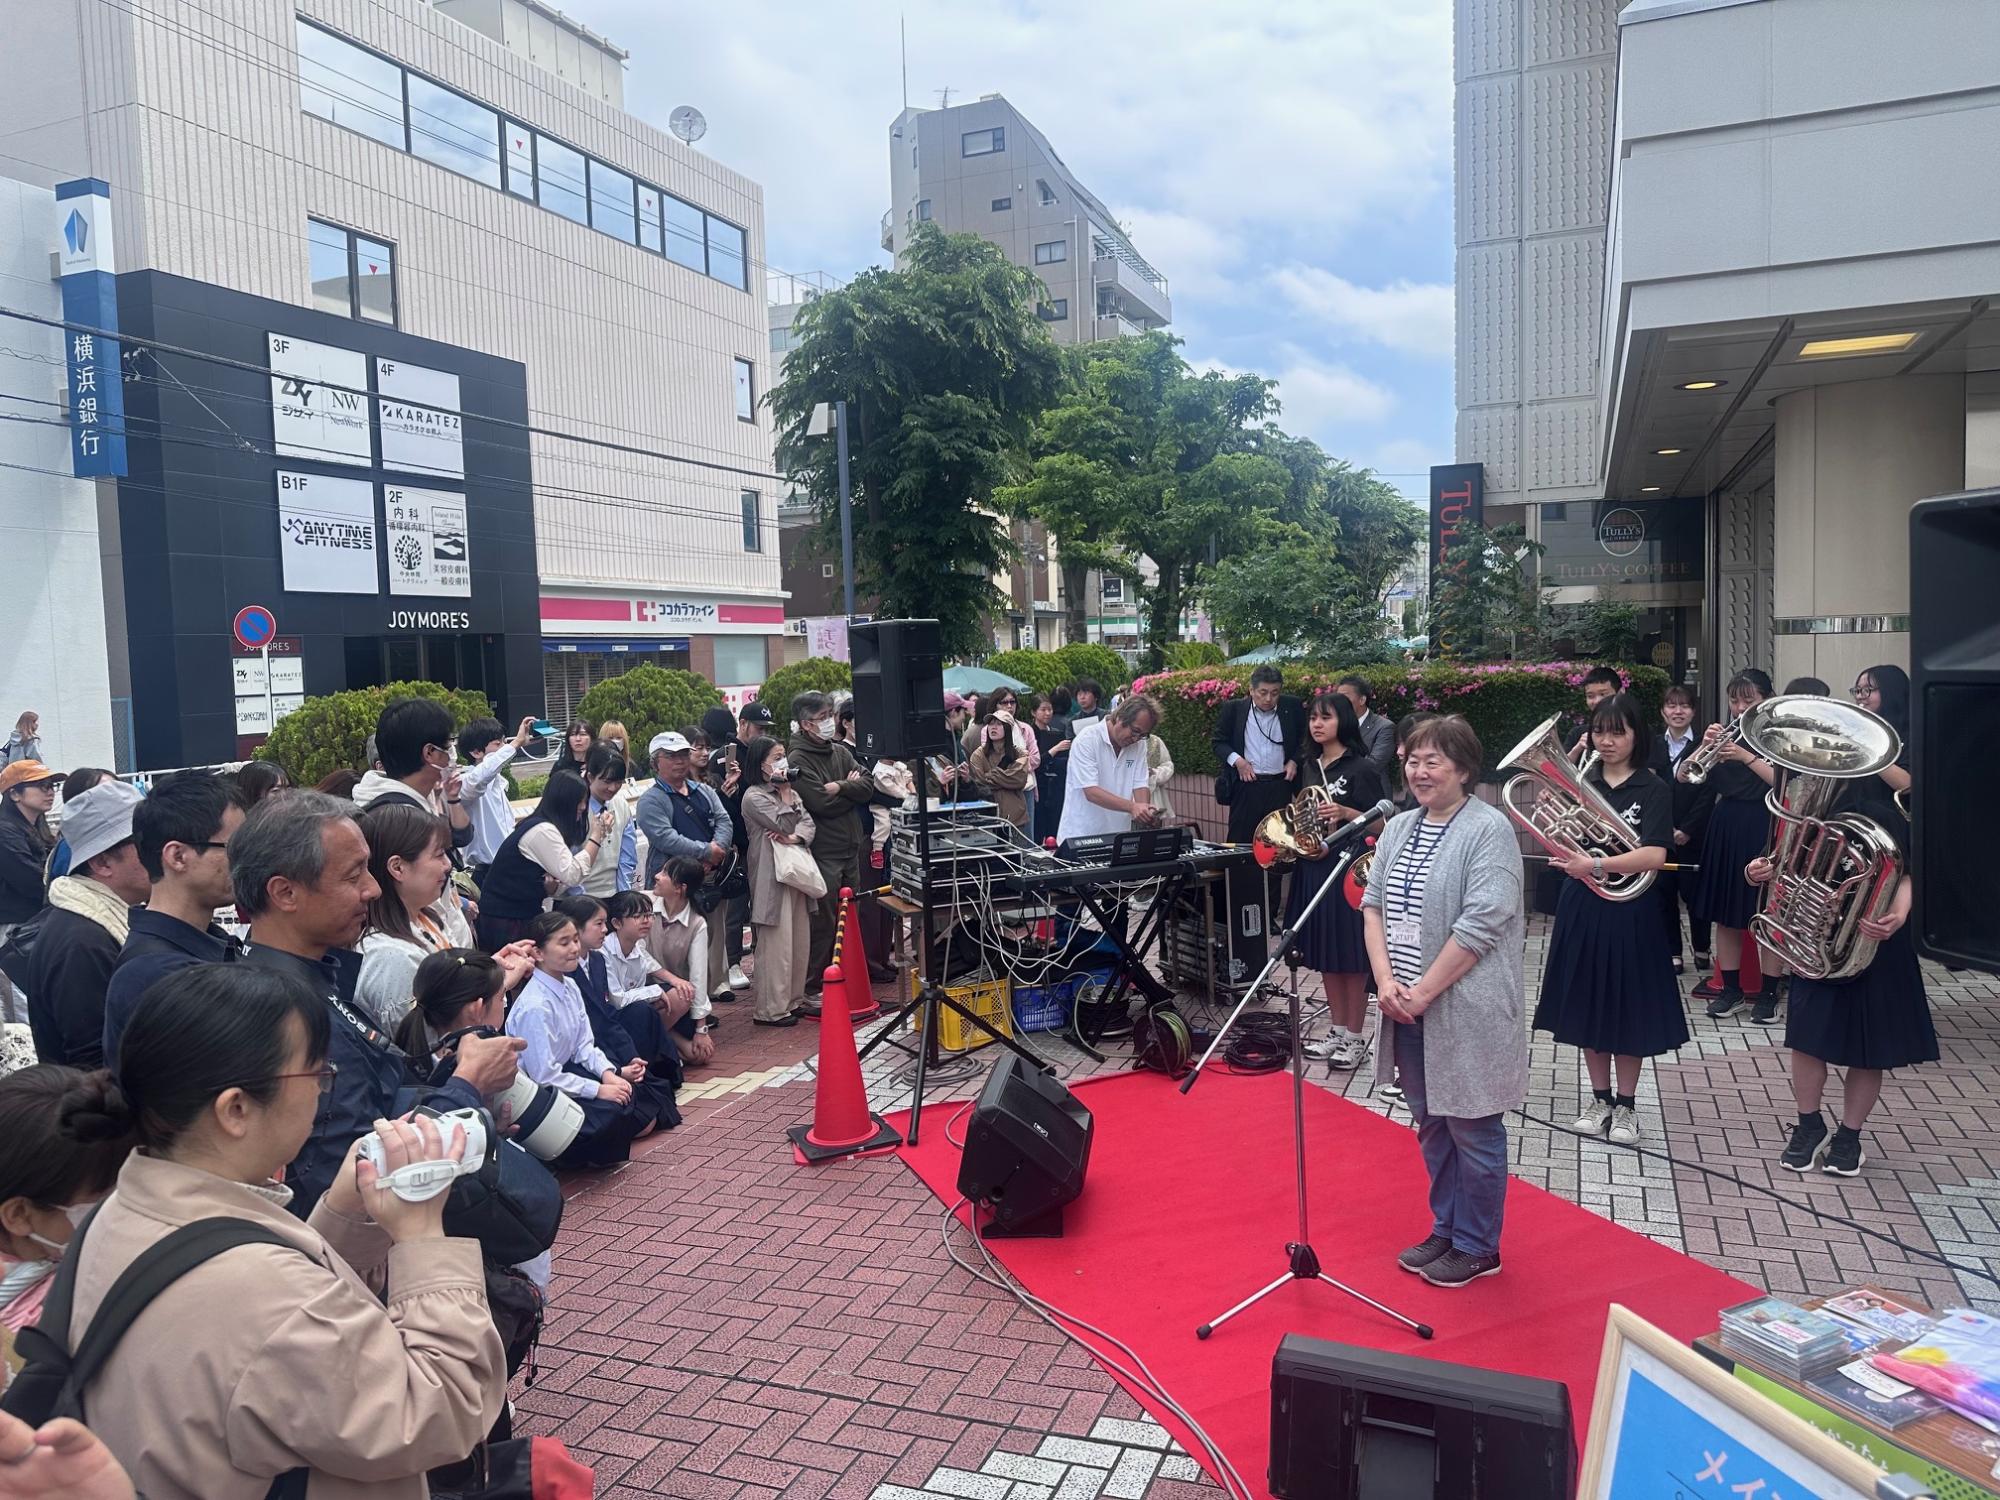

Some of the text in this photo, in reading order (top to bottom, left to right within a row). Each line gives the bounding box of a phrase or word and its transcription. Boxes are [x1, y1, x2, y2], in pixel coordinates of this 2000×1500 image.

[273, 339, 290, 354] 3F
[380, 363, 395, 376] 4F
[74, 334, 100, 456] 横浜銀行
[332, 391, 360, 411] NW
[396, 407, 459, 429] KARATEZ
[281, 476, 308, 491] B1F
[389, 490, 403, 503] 2F
[303, 521, 372, 539] ANYTIME
[1603, 524, 1641, 537] TULLY'S
[304, 535, 373, 550] FITNESS
[1556, 562, 1690, 579] TULLY'S COFFEE
[658, 602, 714, 617] ココカラファイン
[388, 611, 469, 629] JOYMORE'S
[1081, 837, 1104, 846] YAMAHA
[327, 994, 367, 1033] SONY
